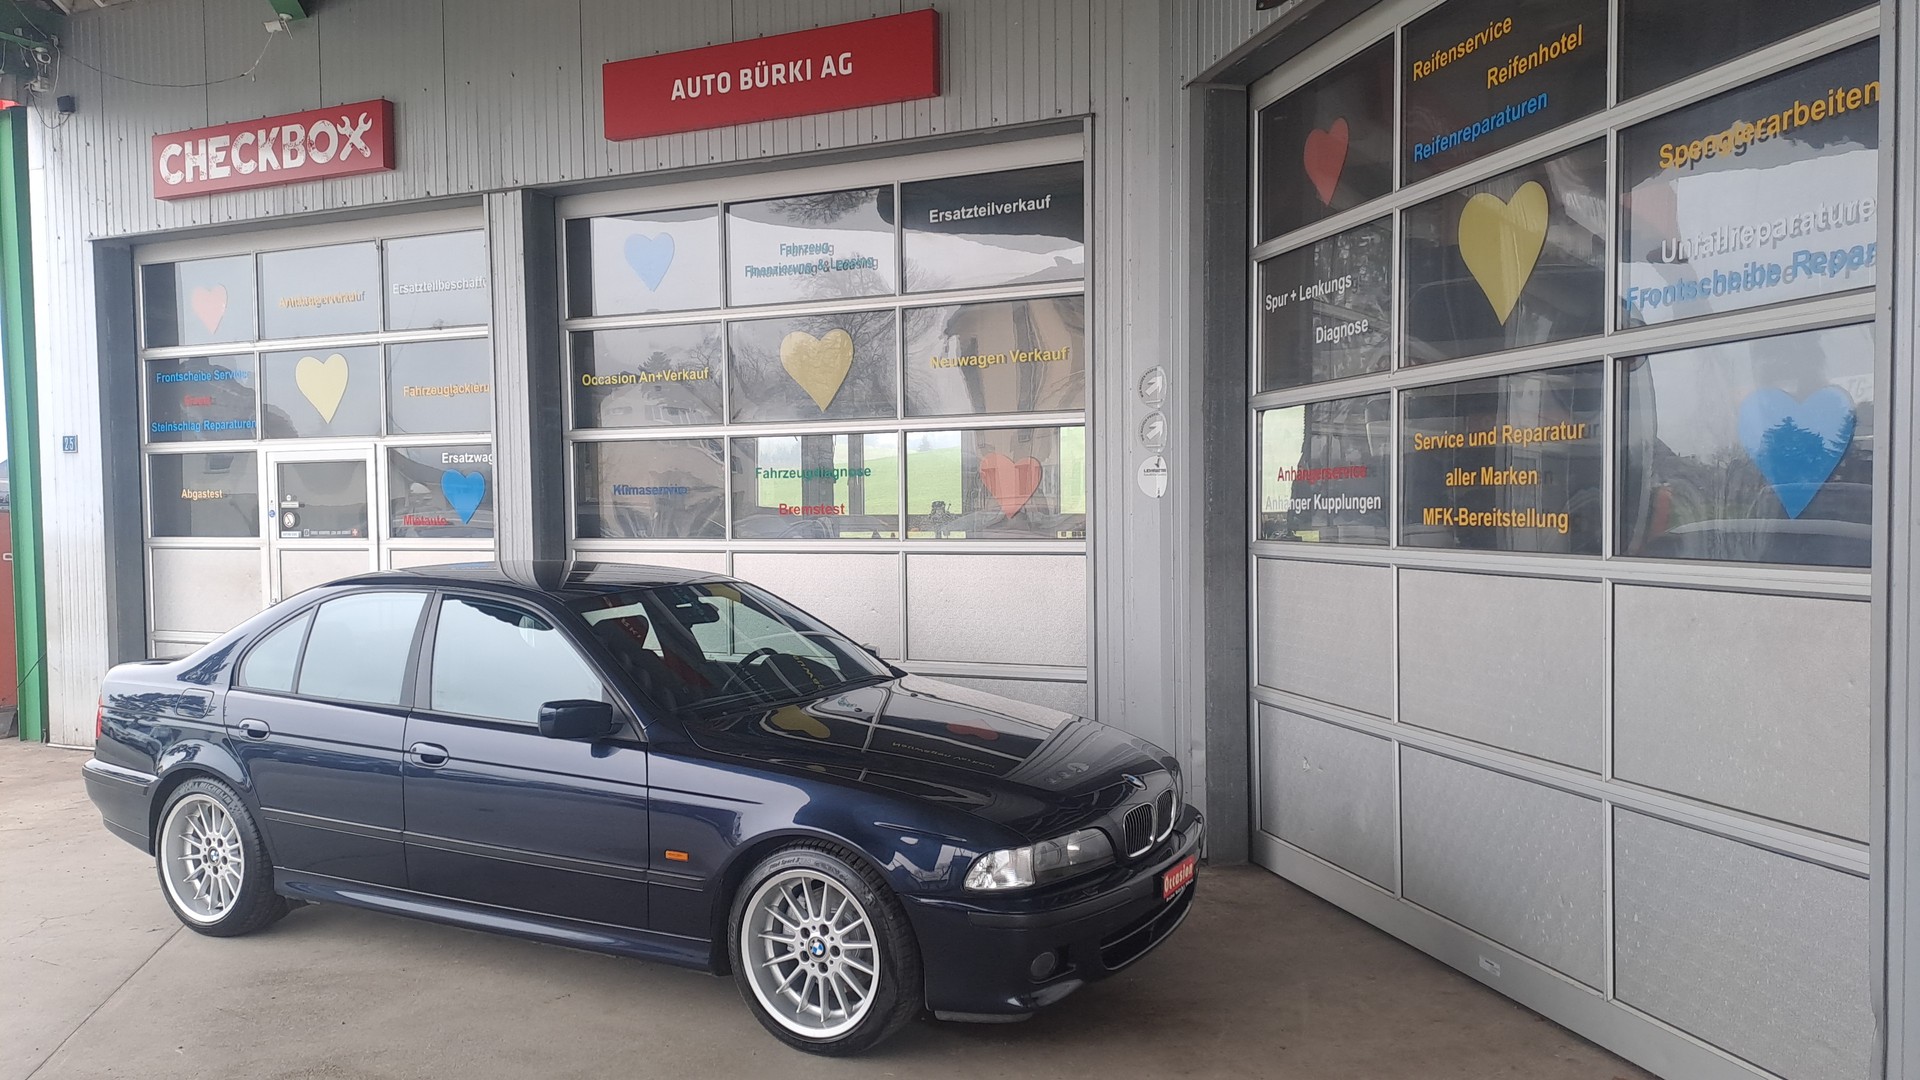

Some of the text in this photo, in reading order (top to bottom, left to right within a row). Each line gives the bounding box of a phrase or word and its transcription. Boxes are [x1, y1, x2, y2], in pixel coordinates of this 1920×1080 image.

[1413, 17, 1512, 81] Reifenservice
[1487, 24, 1583, 89] Reifenhotel
[671, 53, 852, 100] AUTO BÜRKI AG
[1414, 92, 1548, 162] Reifenreparaturen
[1659, 81, 1880, 169] Spenglerarbeiten
[159, 112, 373, 185] CHECKBOX
[929, 194, 1052, 223] Ersatzteilverkauf
[1265, 274, 1352, 313] Spur + Lenkungs
[1625, 255, 1797, 312] Frontscheibe
[1315, 319, 1369, 344] Diagnose
[929, 345, 1069, 369] Neuwagen Verkauf
[156, 370, 212, 383] Frontscheibe
[582, 366, 709, 386] Occasion An+Verkauf
[151, 421, 202, 433] Steinschlag
[1414, 421, 1586, 451] Service und Reparatur
[64, 438, 74, 450] 25
[756, 467, 872, 483] Fahrzeugdiagnose
[1277, 465, 1368, 486] Anhängerservice
[1445, 466, 1538, 486] aller Marken
[181, 489, 223, 501] Abgastest
[1265, 493, 1382, 514] Anhänger Kupplungen
[779, 503, 845, 516] Bremstest
[1423, 507, 1569, 534] MFK-Bereitstellung
[200, 782, 233, 803] MICHELIN
[1164, 862, 1193, 893] Occasion
